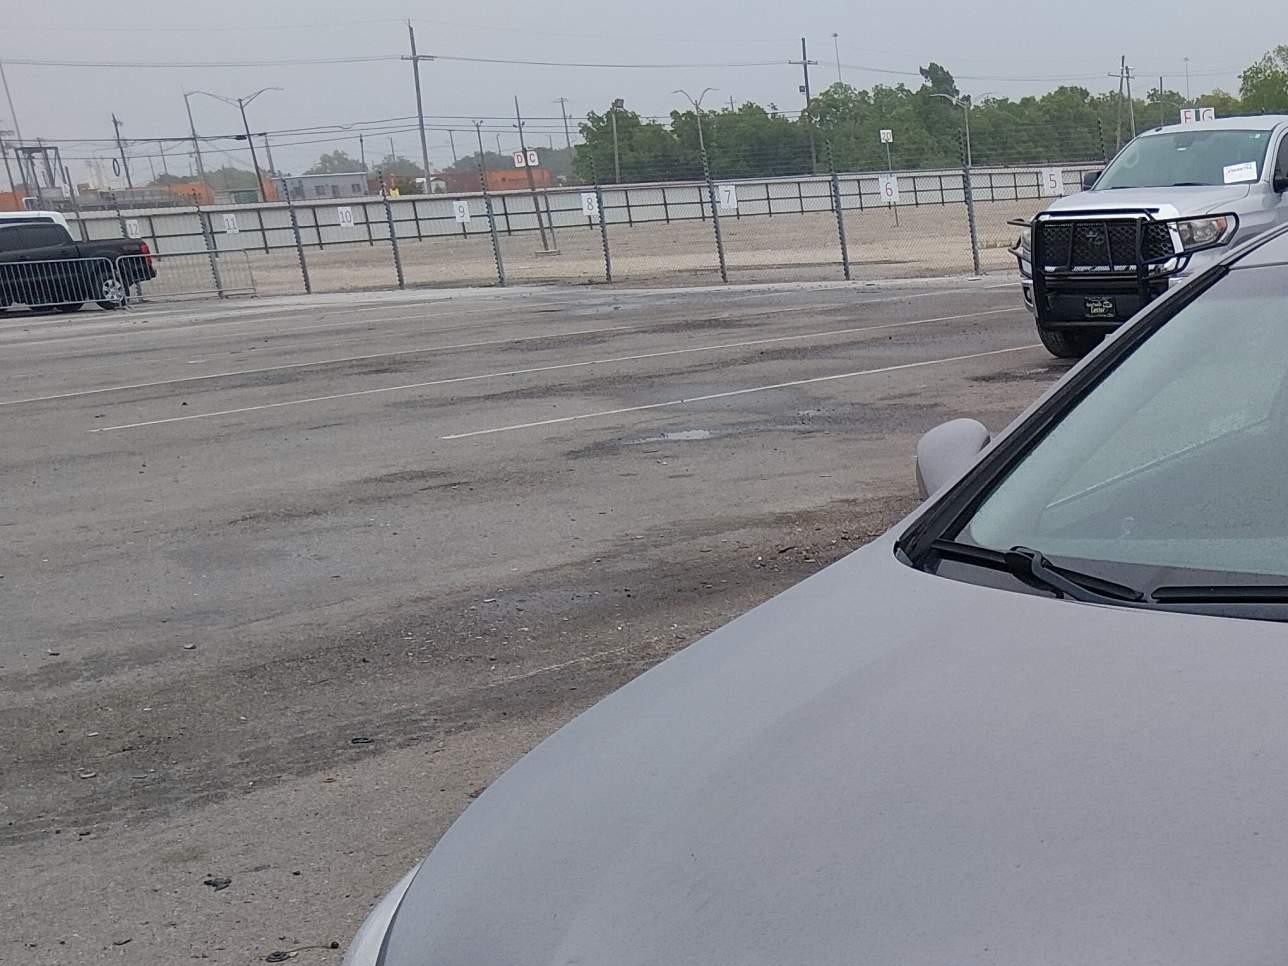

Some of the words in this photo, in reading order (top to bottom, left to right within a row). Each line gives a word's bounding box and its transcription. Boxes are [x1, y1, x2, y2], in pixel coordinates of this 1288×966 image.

[516, 154, 523, 163] D
[529, 152, 535, 162] C
[1049, 173, 1057, 188] 5
[885, 182, 893, 197] 6
[587, 197, 594, 211] 8
[724, 190, 731, 204] 7
[339, 209, 352, 224] 10
[458, 204, 465, 217] 9
